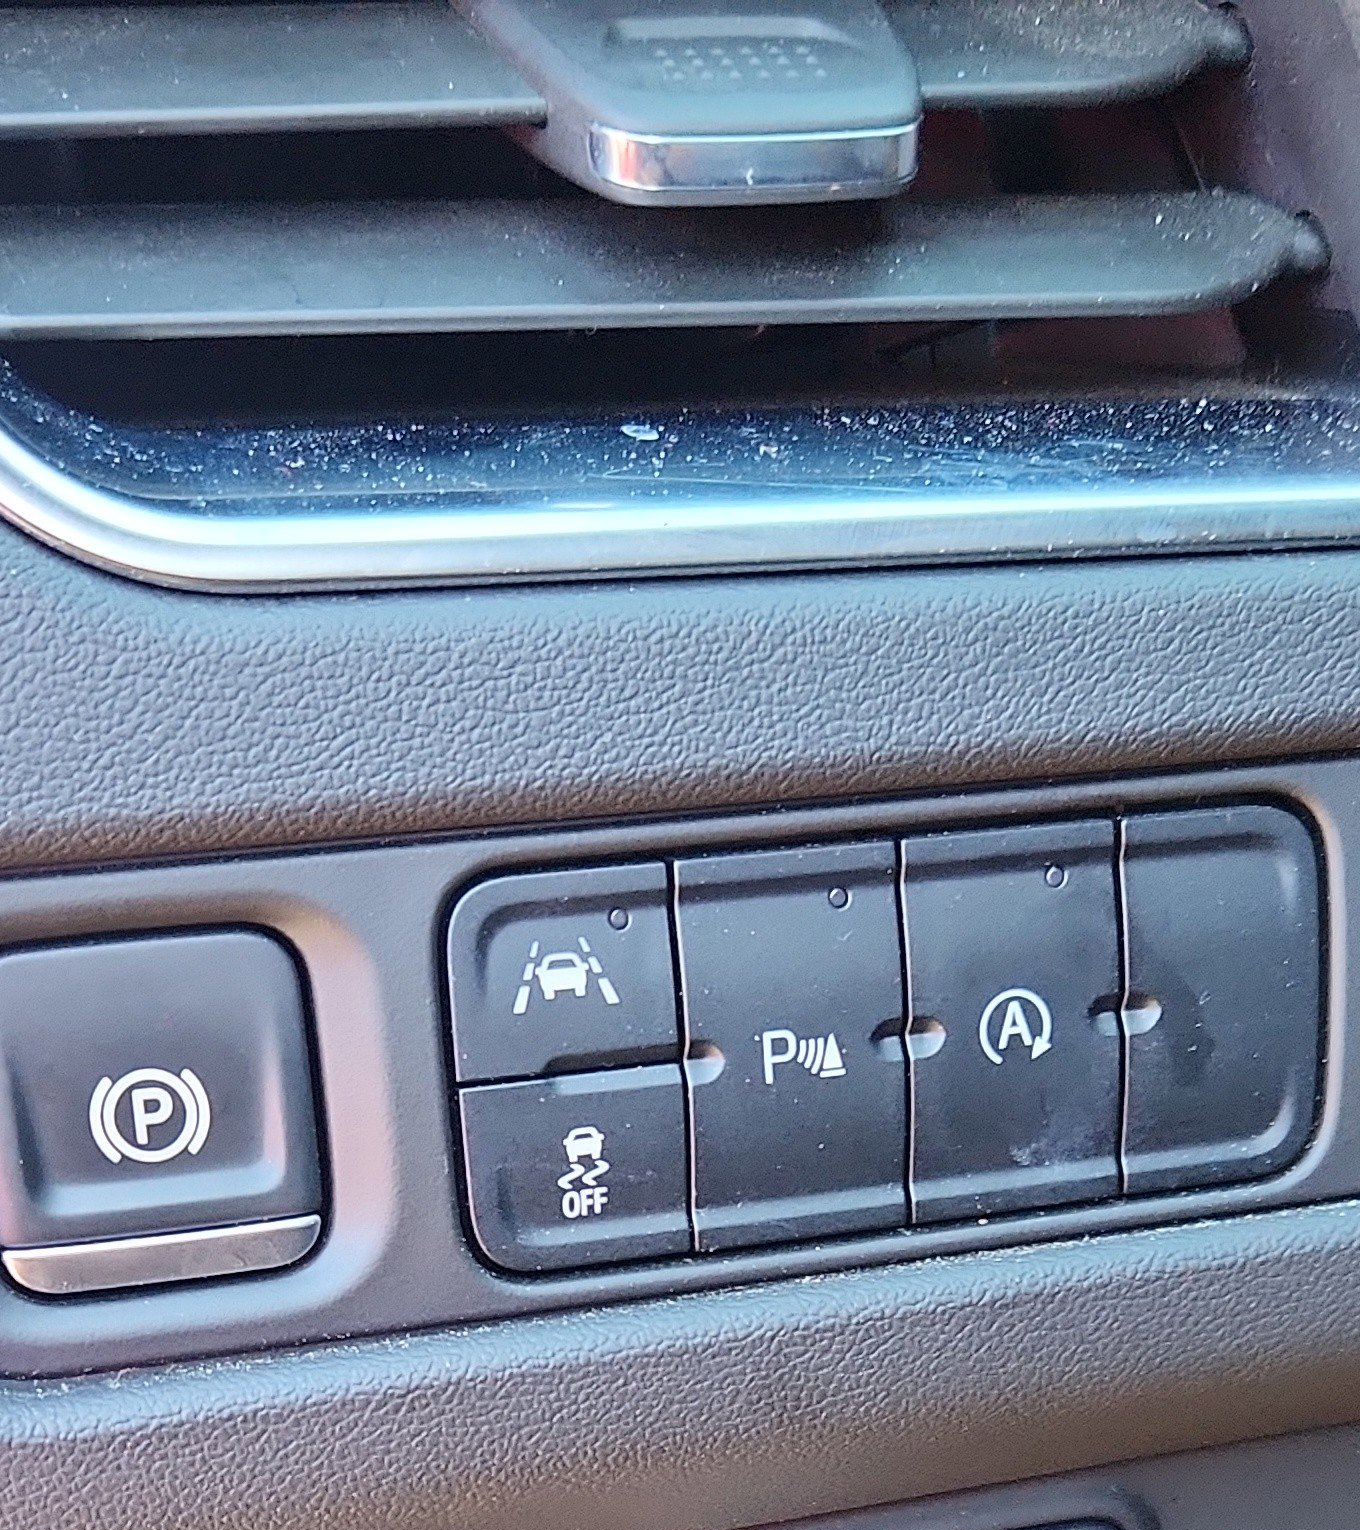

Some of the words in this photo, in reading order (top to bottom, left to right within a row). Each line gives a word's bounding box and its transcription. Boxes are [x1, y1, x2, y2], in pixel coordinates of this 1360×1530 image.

[998, 1001, 1032, 1049] A
[762, 1029, 798, 1085] P
[130, 1087, 173, 1143] P
[562, 1187, 608, 1218] OFF
